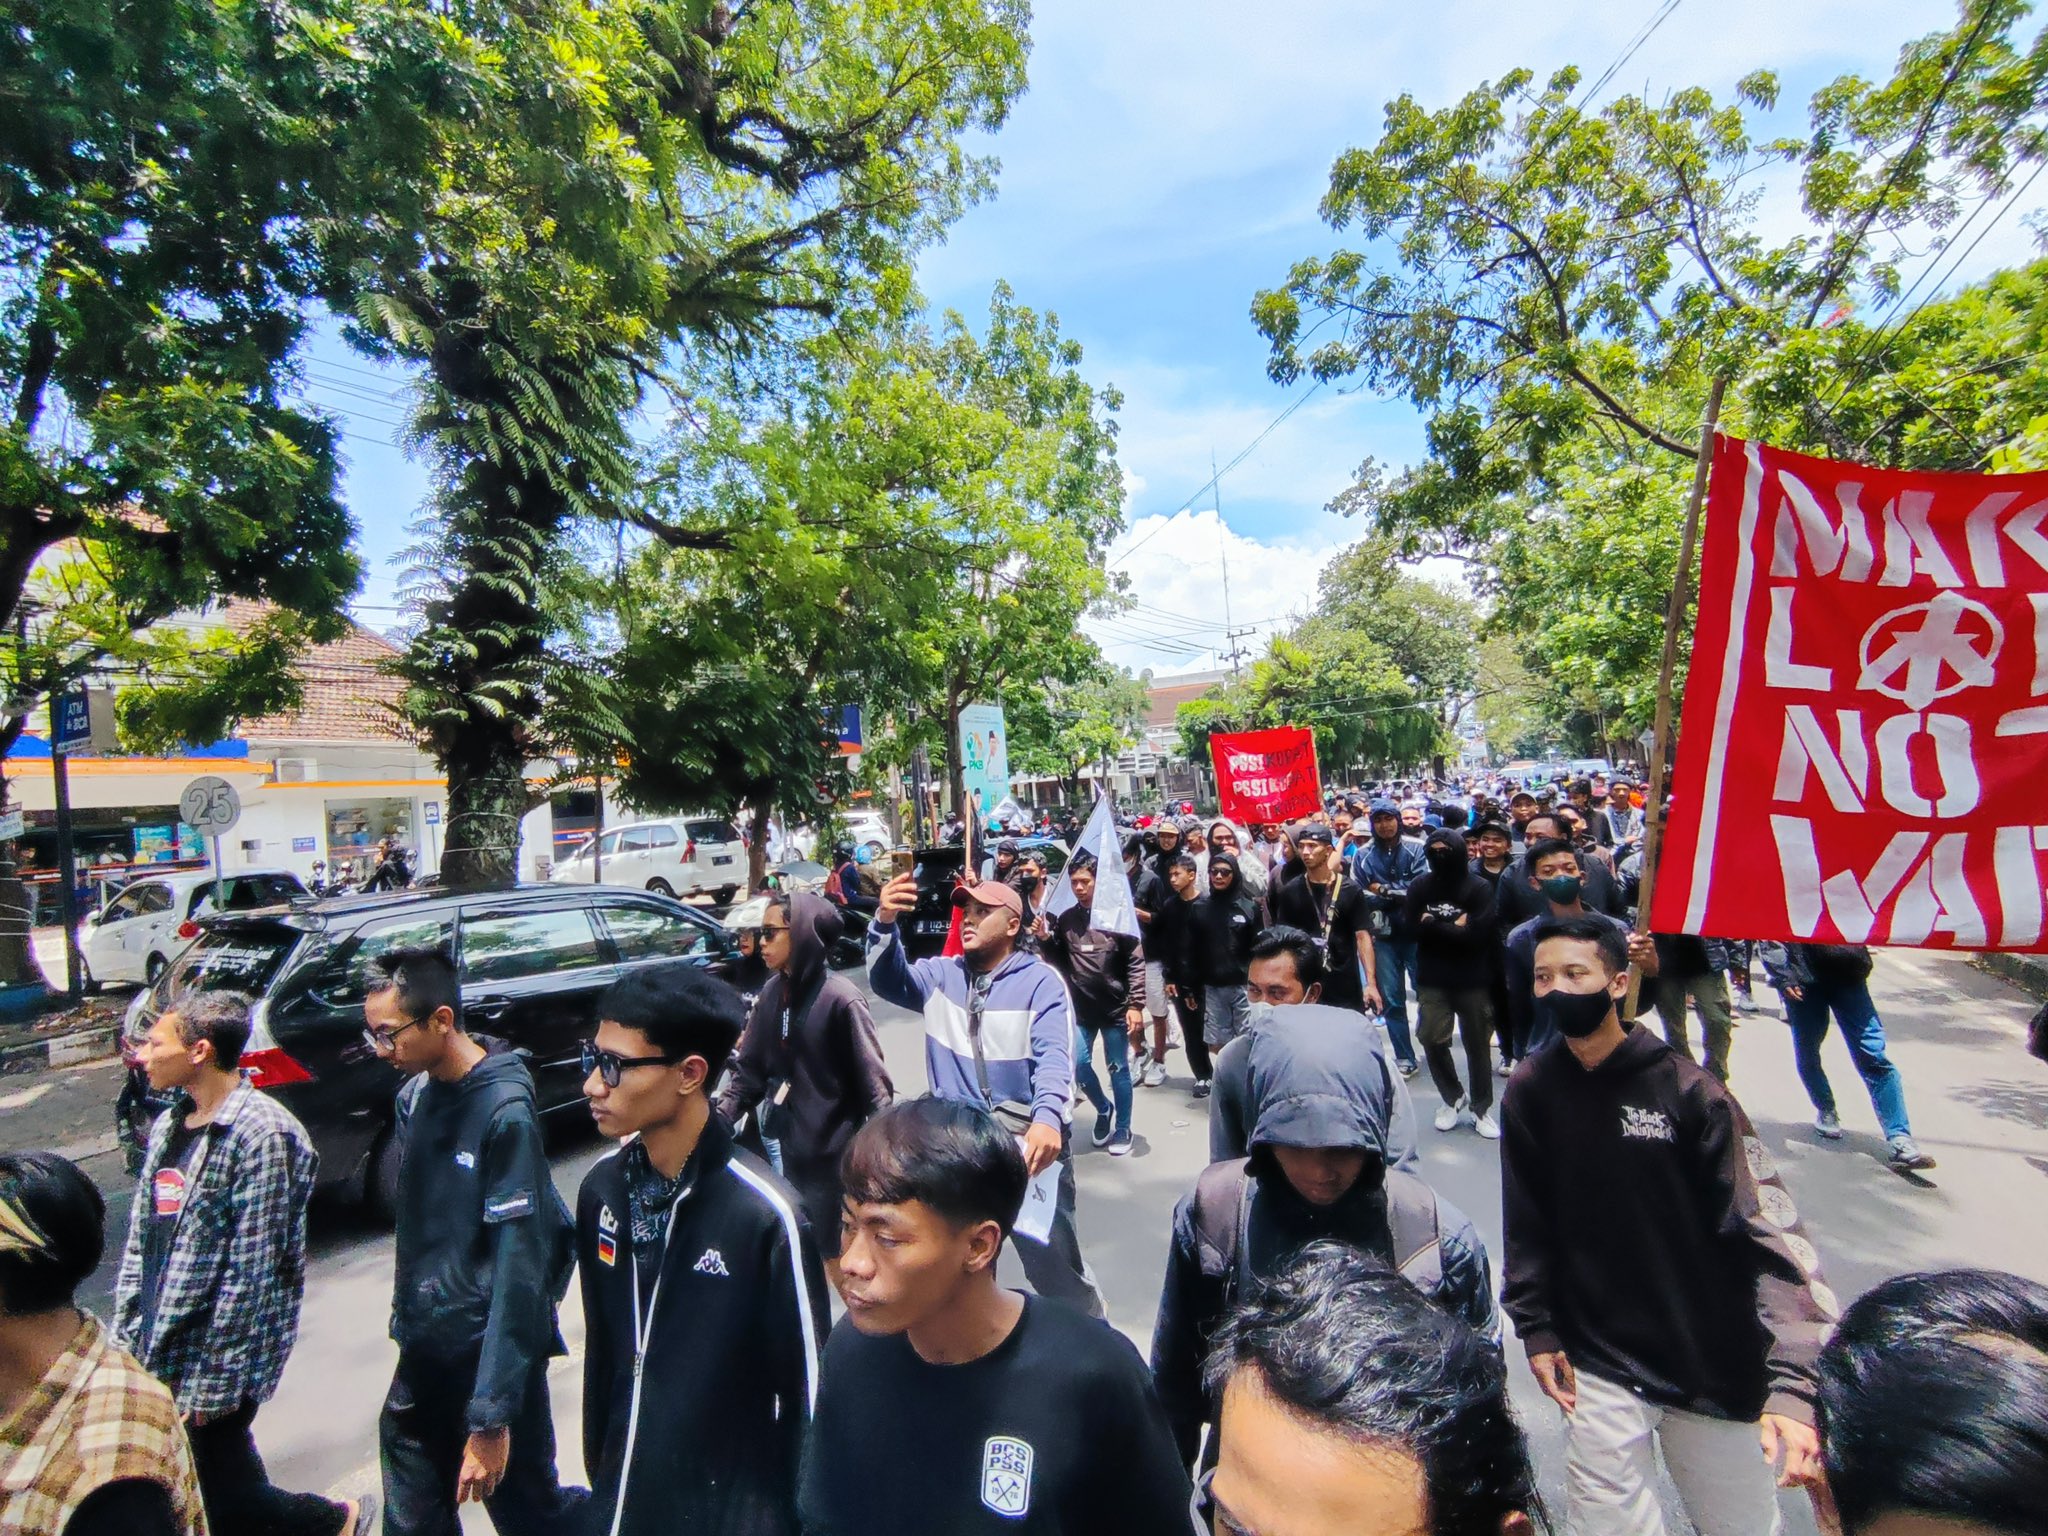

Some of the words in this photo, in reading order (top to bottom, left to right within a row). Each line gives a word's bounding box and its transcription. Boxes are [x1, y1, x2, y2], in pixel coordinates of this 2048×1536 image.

[67, 701, 83, 717] ATM
[73, 715, 89, 731] BCA
[969, 760, 984, 770] PKB
[1229, 752, 1265, 775] PSSI
[1233, 778, 1268, 797] PSSI
[188, 788, 233, 826] 25
[991, 1443, 1027, 1461] BCS
[989, 1457, 1025, 1474] PSS
